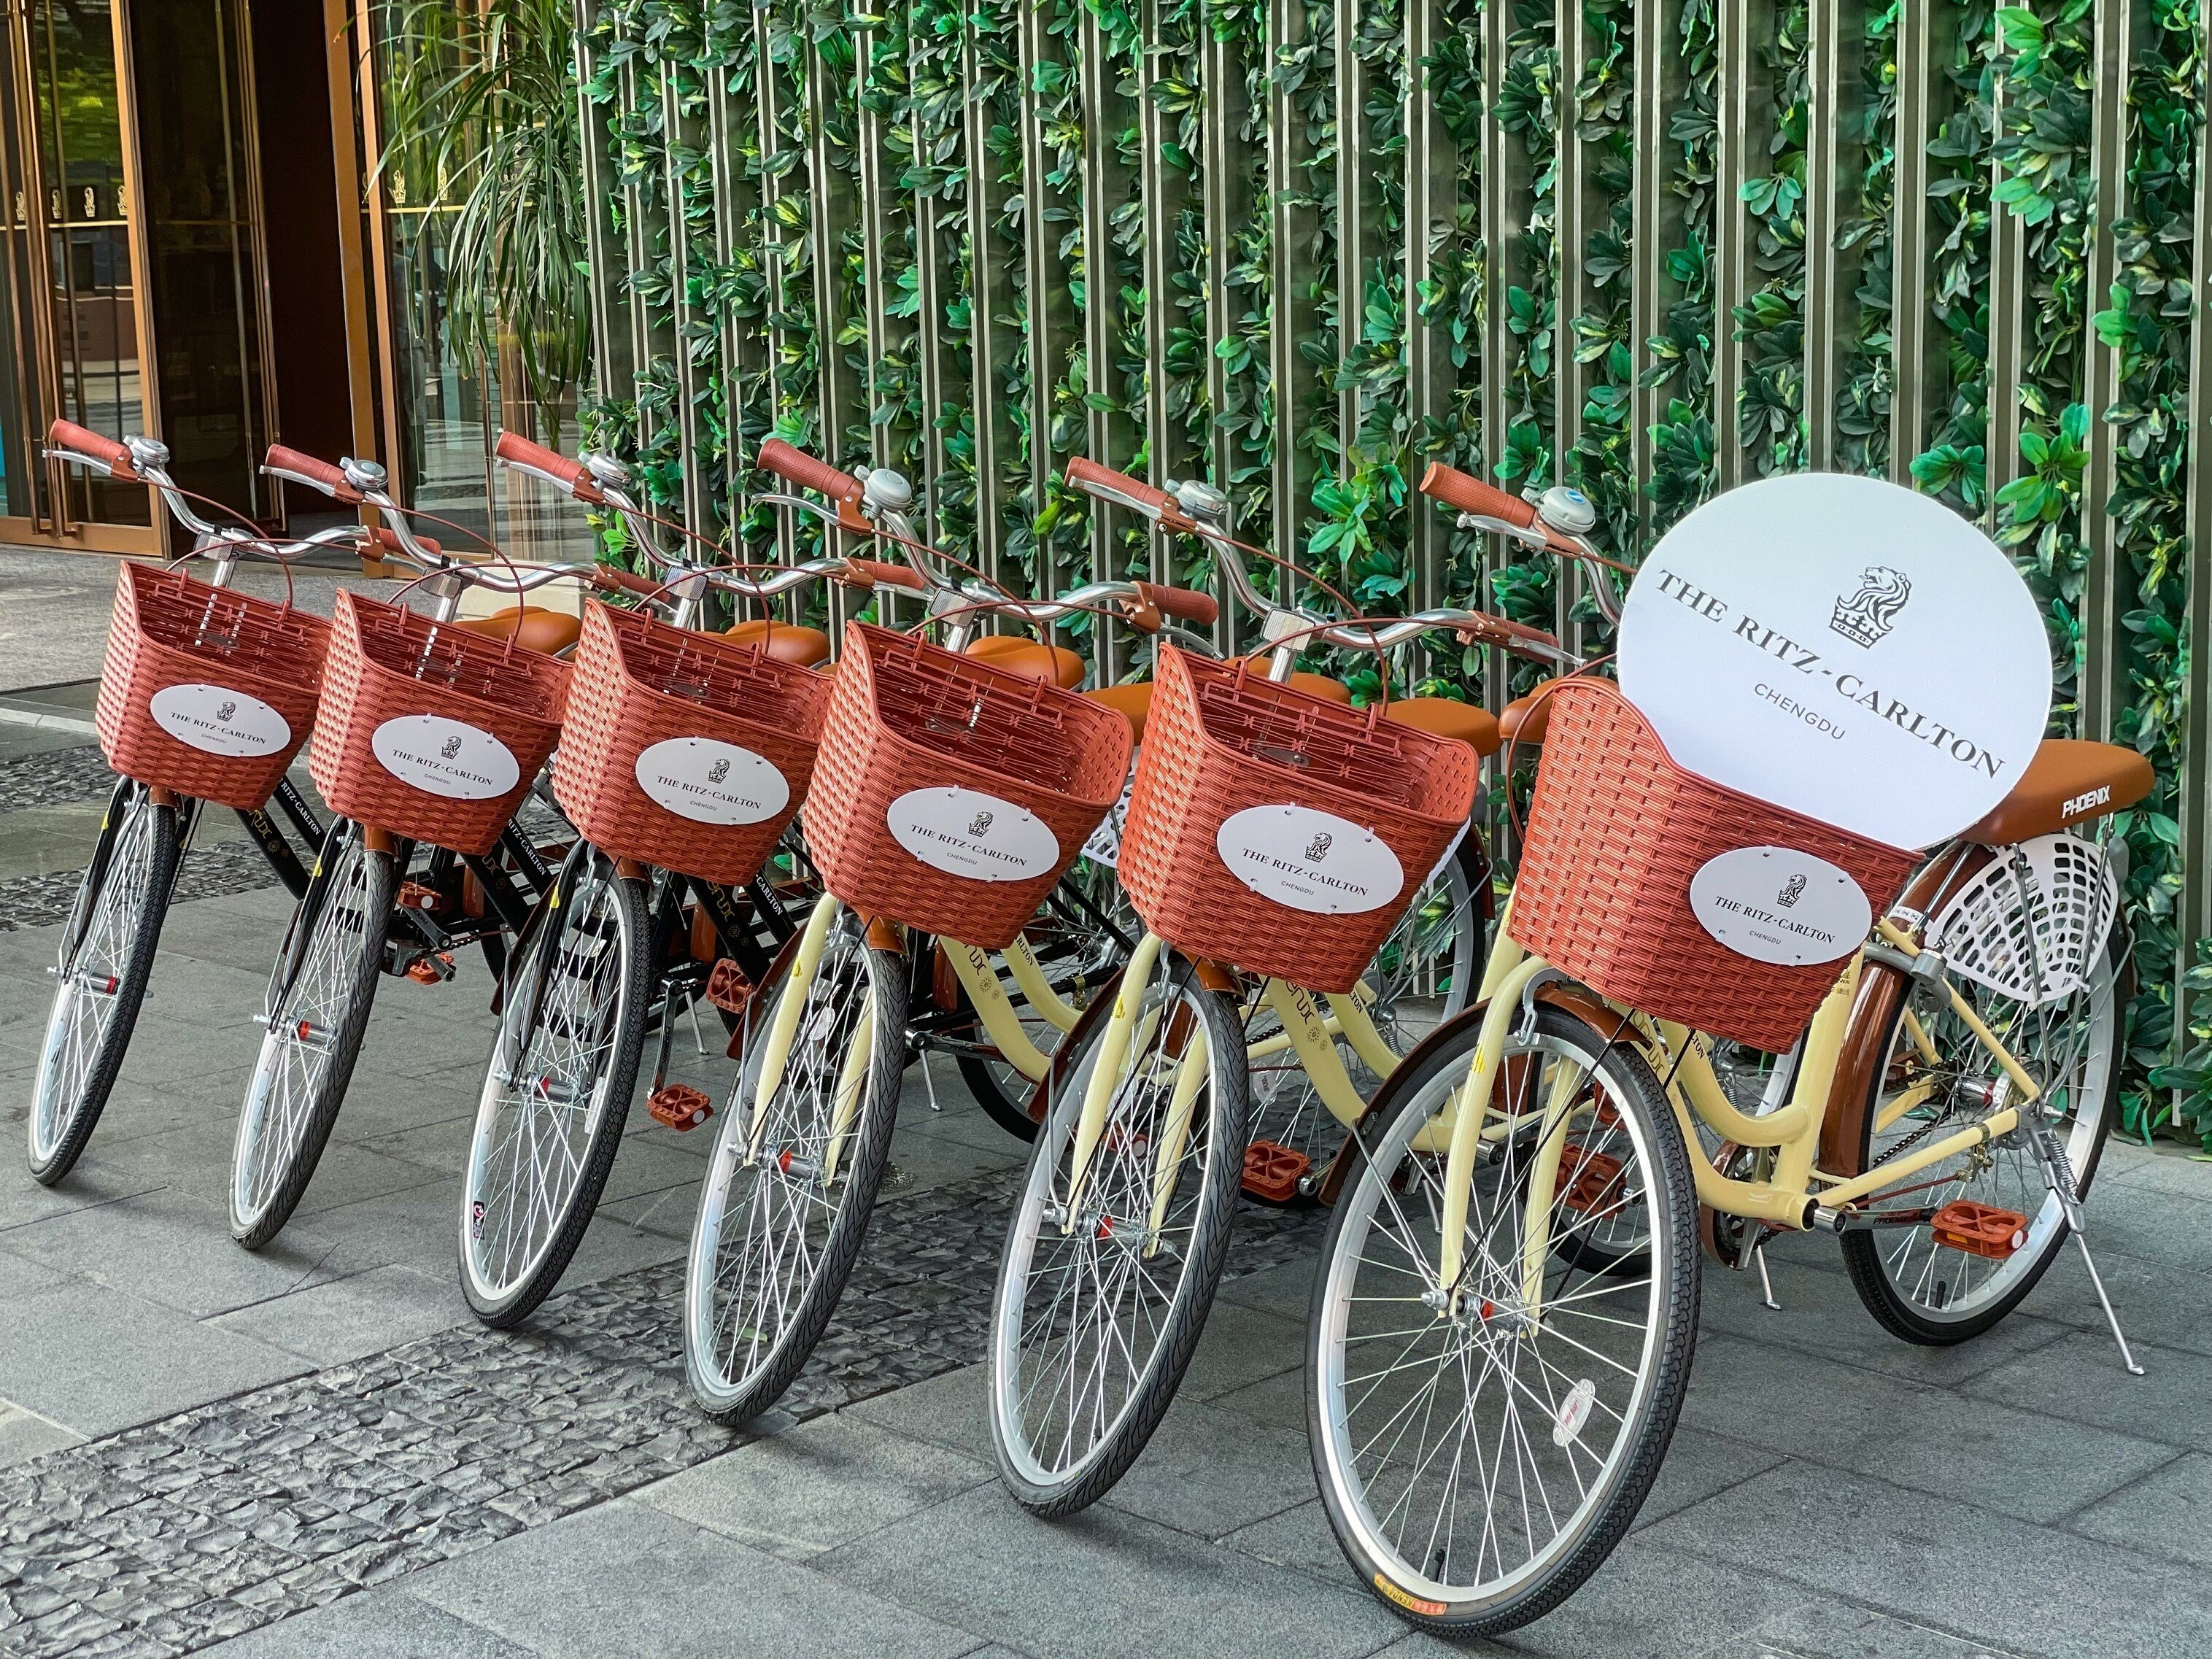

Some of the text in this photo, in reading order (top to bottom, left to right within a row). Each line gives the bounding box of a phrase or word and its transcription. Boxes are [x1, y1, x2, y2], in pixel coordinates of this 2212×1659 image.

[1655, 568, 2006, 780] THE RITZ-CARLTON
[171, 711, 267, 744] THE RITZ-CARLTON
[1753, 682, 1846, 741] CHENGDU
[392, 749, 493, 786] THE RITZ-CARLTON
[657, 776, 762, 810] THE RITZ-CARLTON
[689, 800, 717, 811] CHENGDU
[2062, 785, 2111, 819] PHOENIX
[911, 824, 1027, 867] THE RITZ-CARLTON
[946, 852, 978, 865] CHENGDU
[1242, 848, 1369, 897] THE RITZ-CARLTON
[1280, 881, 1315, 895] CHENGDU
[1714, 896, 1836, 944] THE RITZ-CARLTON
[1749, 930, 1782, 945] CHENGDU
